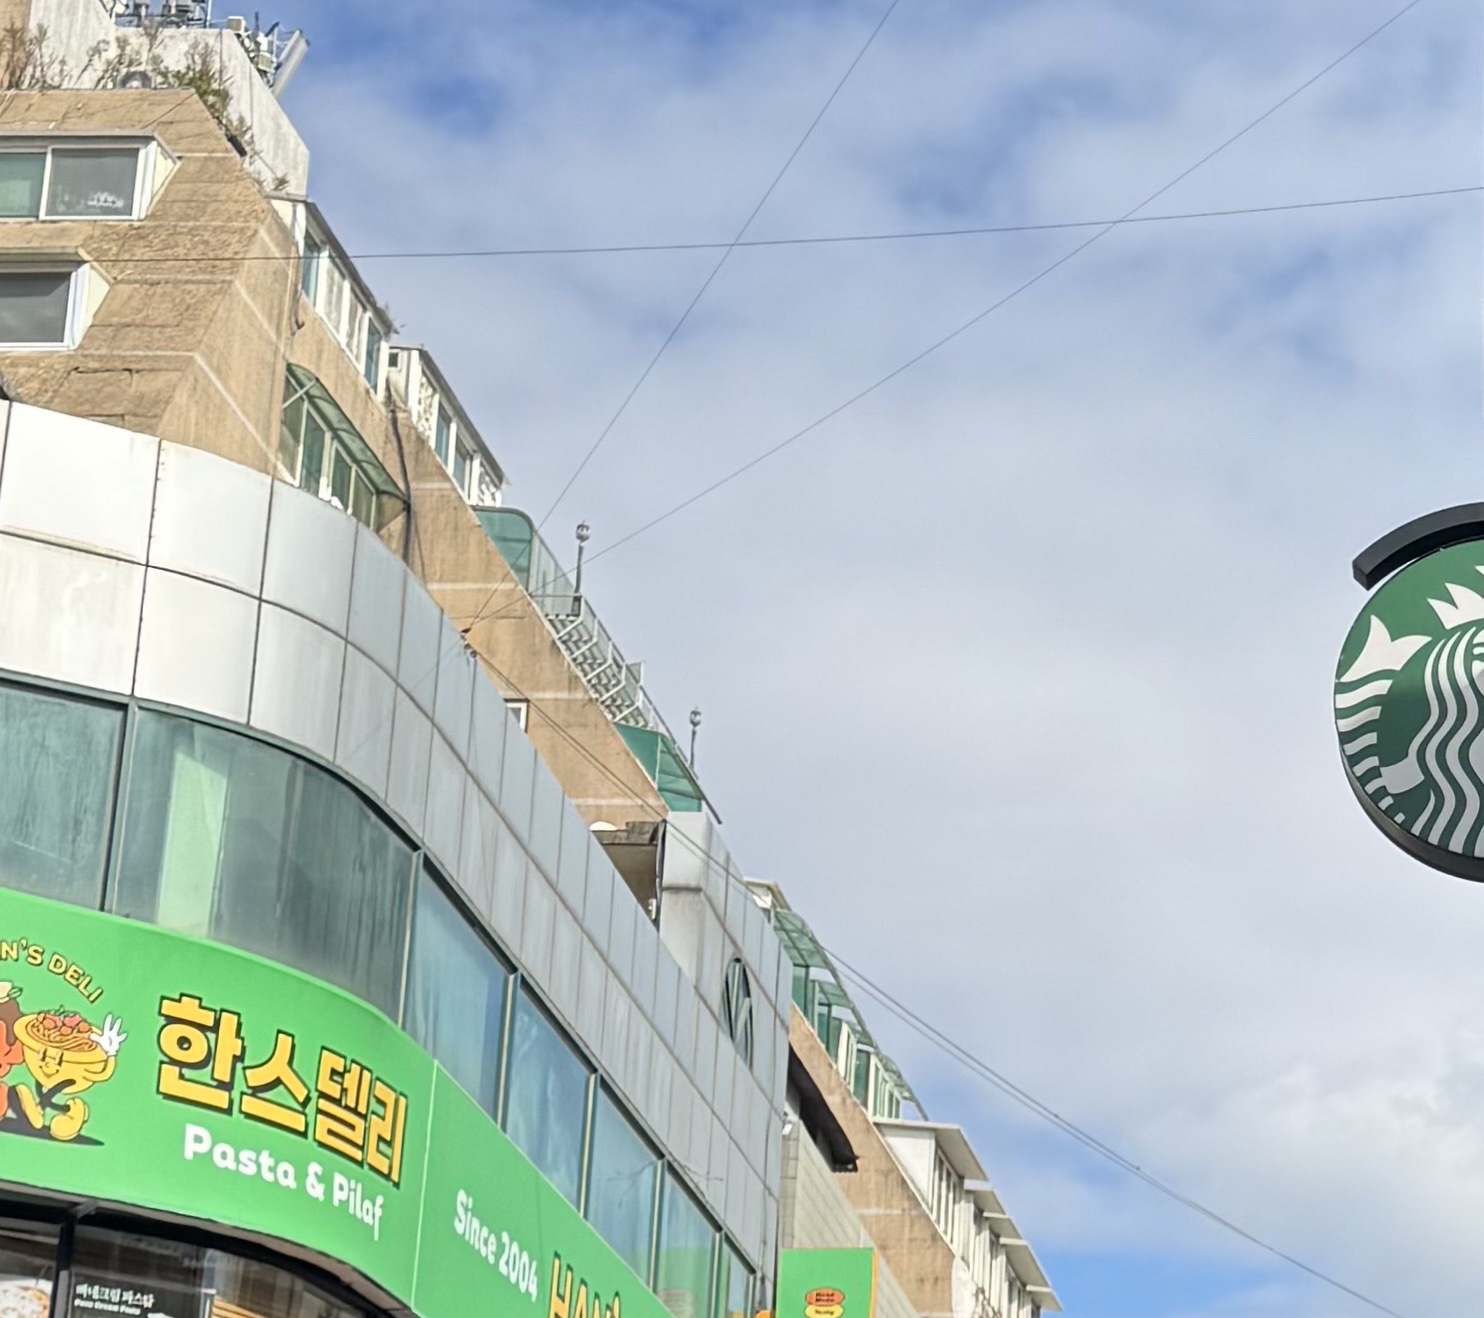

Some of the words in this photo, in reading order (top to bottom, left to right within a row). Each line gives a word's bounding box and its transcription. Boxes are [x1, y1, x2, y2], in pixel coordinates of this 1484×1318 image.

[0, 938, 45, 966] N'S
[48, 952, 104, 1004] DELI
[157, 993, 407, 1190] 한스델리
[183, 1123, 297, 1190] Pasta
[305, 1161, 325, 1202] &
[332, 1171, 385, 1241] Pilaf
[453, 1189, 498, 1265] Since
[498, 1230, 538, 1302] 2004
